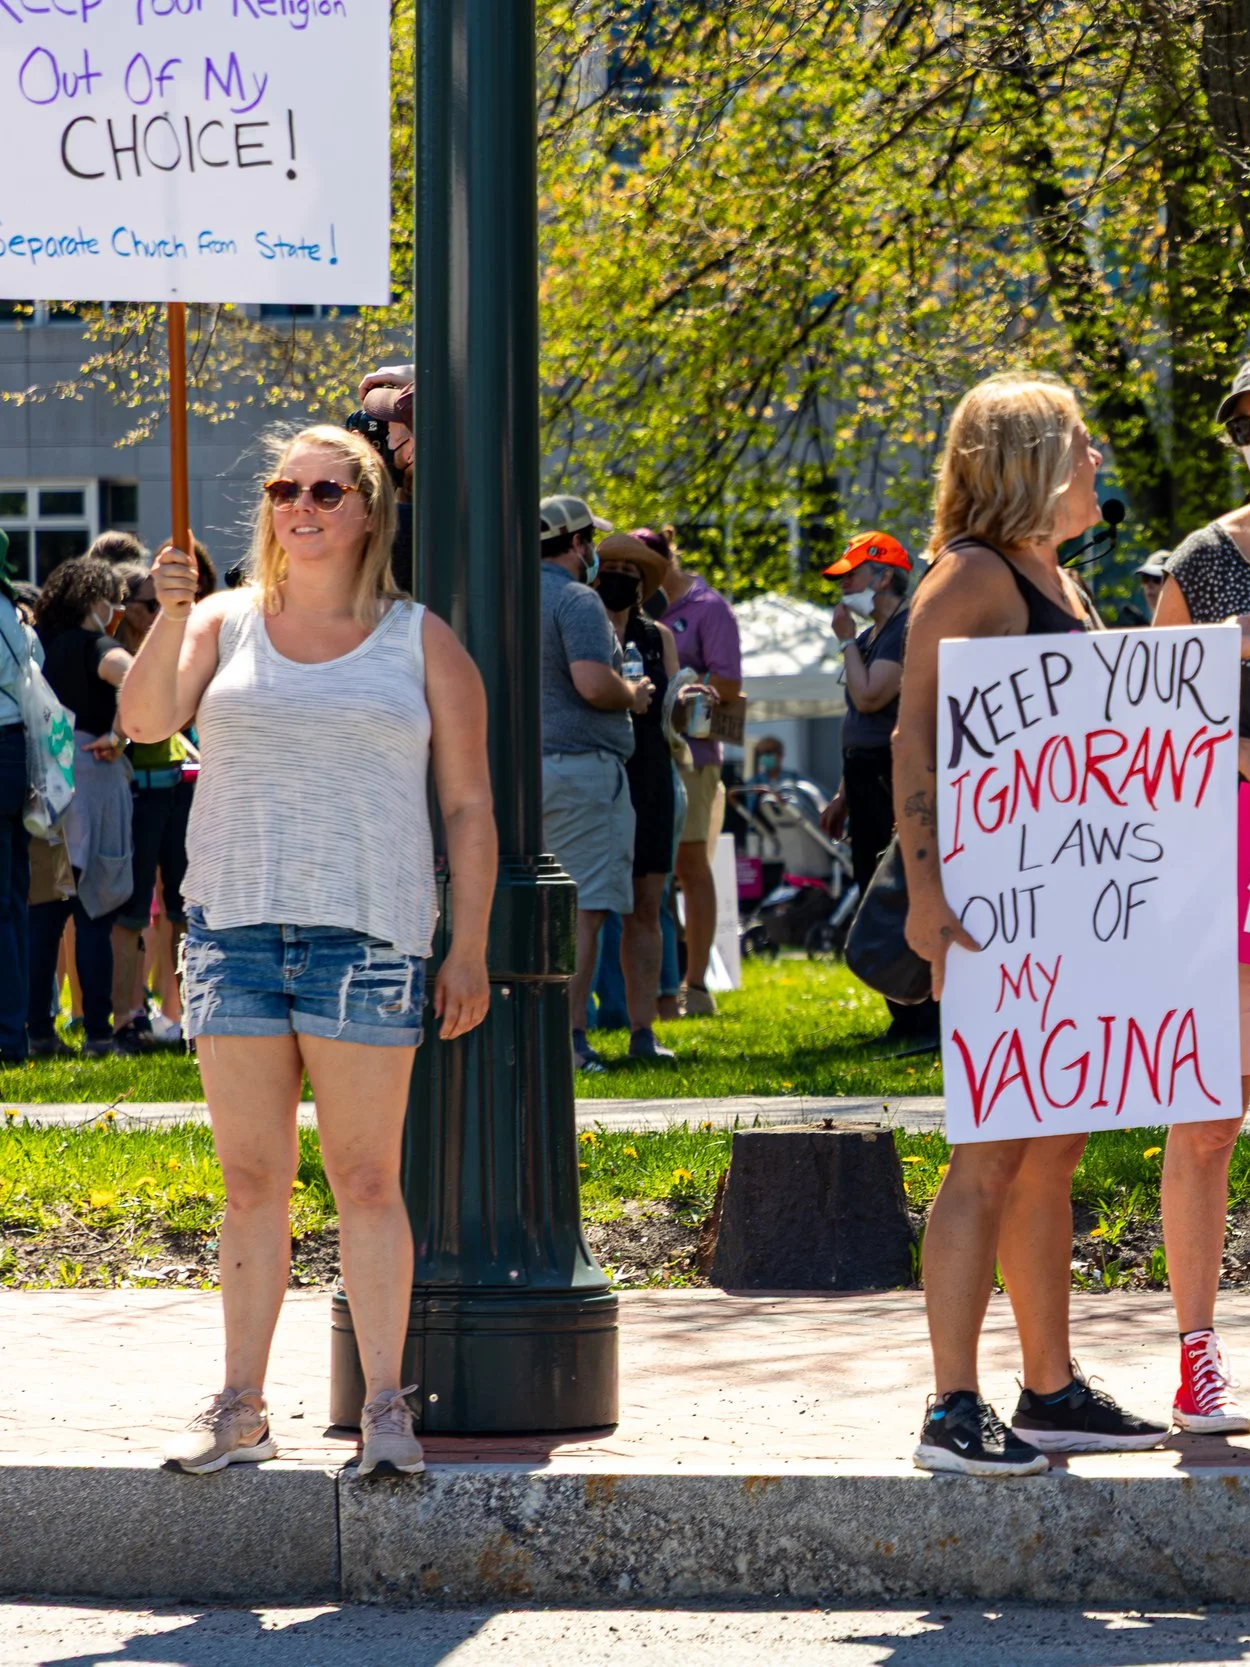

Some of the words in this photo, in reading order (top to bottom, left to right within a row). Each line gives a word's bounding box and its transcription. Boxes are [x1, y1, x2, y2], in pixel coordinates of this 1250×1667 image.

[19, 47, 102, 105] Out
[125, 53, 182, 105] Of
[204, 51, 268, 114] My
[61, 108, 297, 181] CHOICE!
[111, 226, 187, 259] Church
[255, 223, 338, 265] State!
[947, 652, 1073, 769] KEEP
[1093, 635, 1230, 724] YOUR
[943, 727, 1233, 863] IGNORANT
[1019, 819, 1164, 871] LAWS
[958, 884, 1045, 951] OUT
[1093, 876, 1159, 942] OF
[996, 954, 1062, 1031] MY
[952, 1008, 1221, 1128] VAGINA
